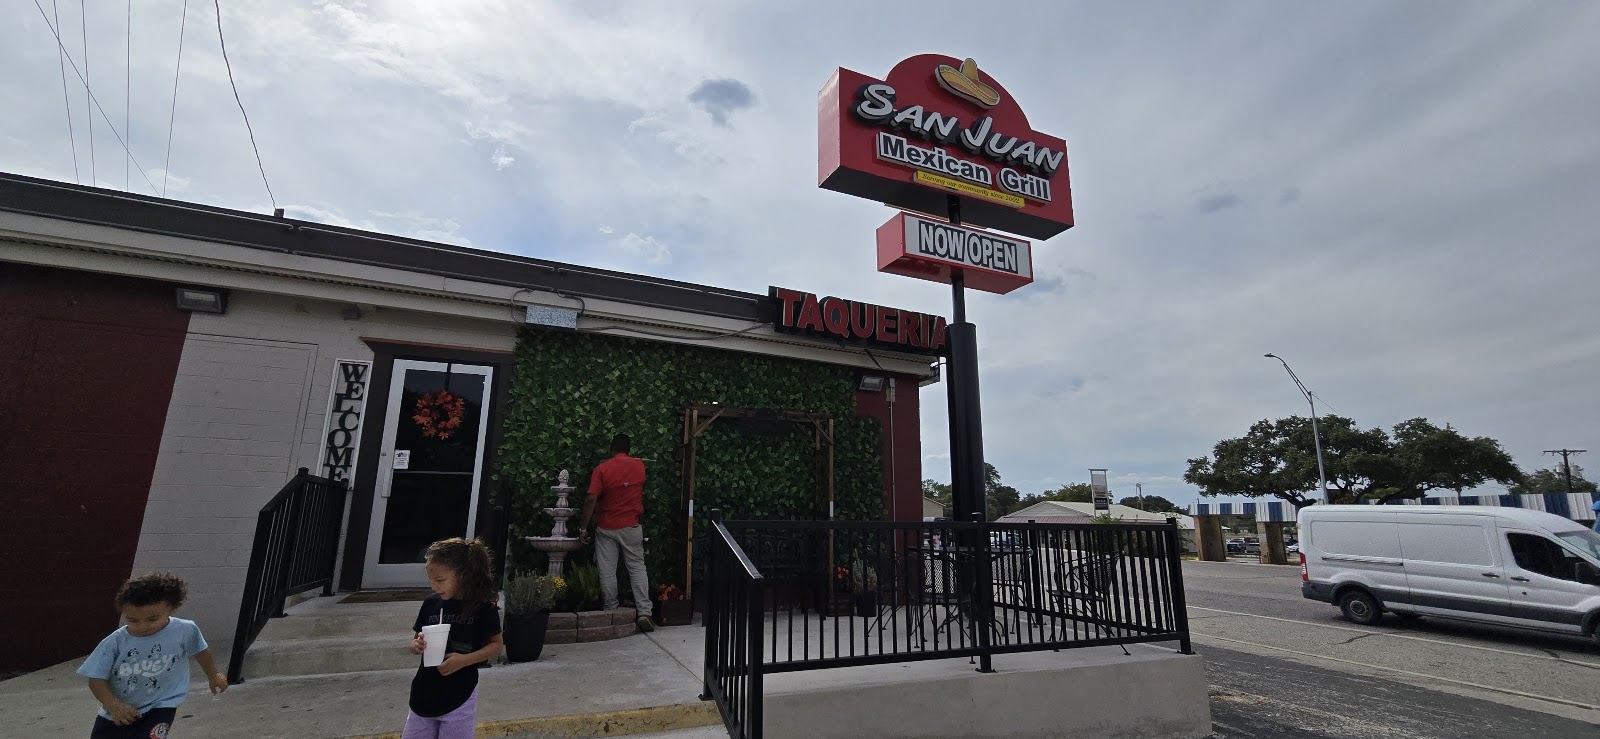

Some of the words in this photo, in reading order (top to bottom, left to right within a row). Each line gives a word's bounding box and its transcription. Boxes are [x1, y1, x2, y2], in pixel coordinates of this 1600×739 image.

[857, 84, 957, 138] SAN
[962, 116, 1064, 171] JUAN
[883, 134, 989, 183] Mexican
[1001, 170, 1050, 199] Grill
[922, 173, 946, 185] Serving
[958, 183, 989, 196] community
[991, 191, 1003, 200] since
[920, 222, 964, 260] NOW
[968, 235, 1017, 273] OPEN
[777, 287, 947, 350] TAQUERIA
[323, 362, 368, 481] WELCOME
[119, 654, 172, 677] BLUEY
